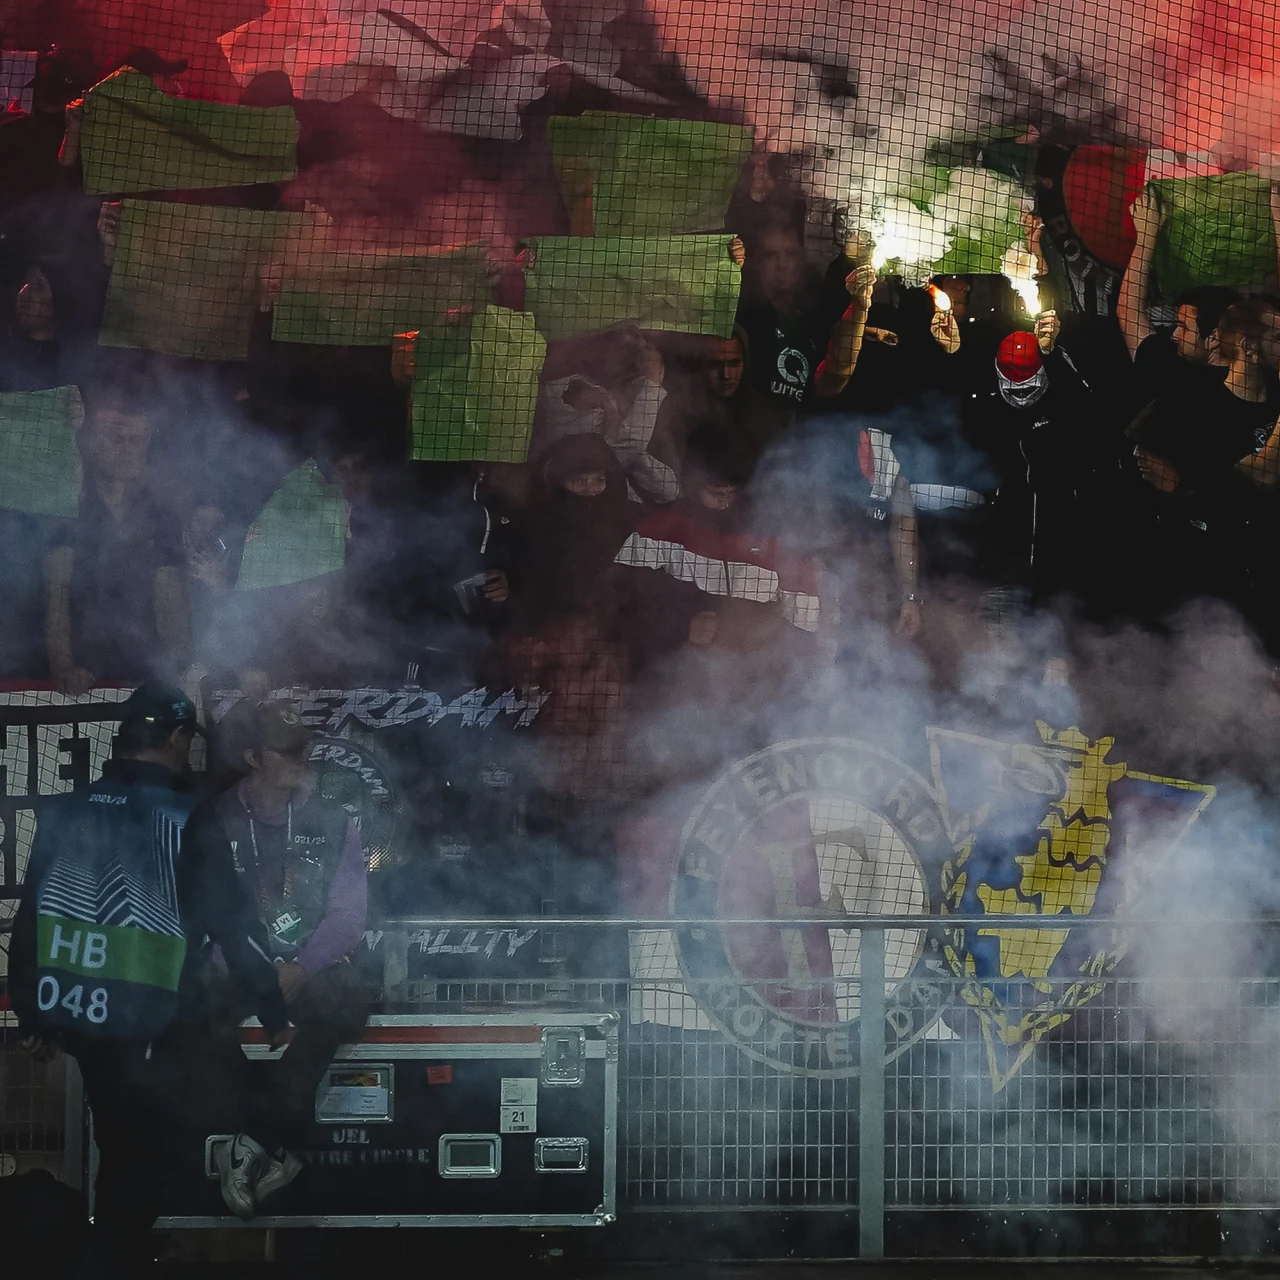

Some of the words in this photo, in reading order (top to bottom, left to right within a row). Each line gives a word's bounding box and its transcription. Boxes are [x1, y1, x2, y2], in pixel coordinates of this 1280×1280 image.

[50, 924, 108, 969] HB
[37, 974, 109, 1024] 048
[512, 1111, 526, 1123] 21
[332, 1127, 371, 1144] UEL
